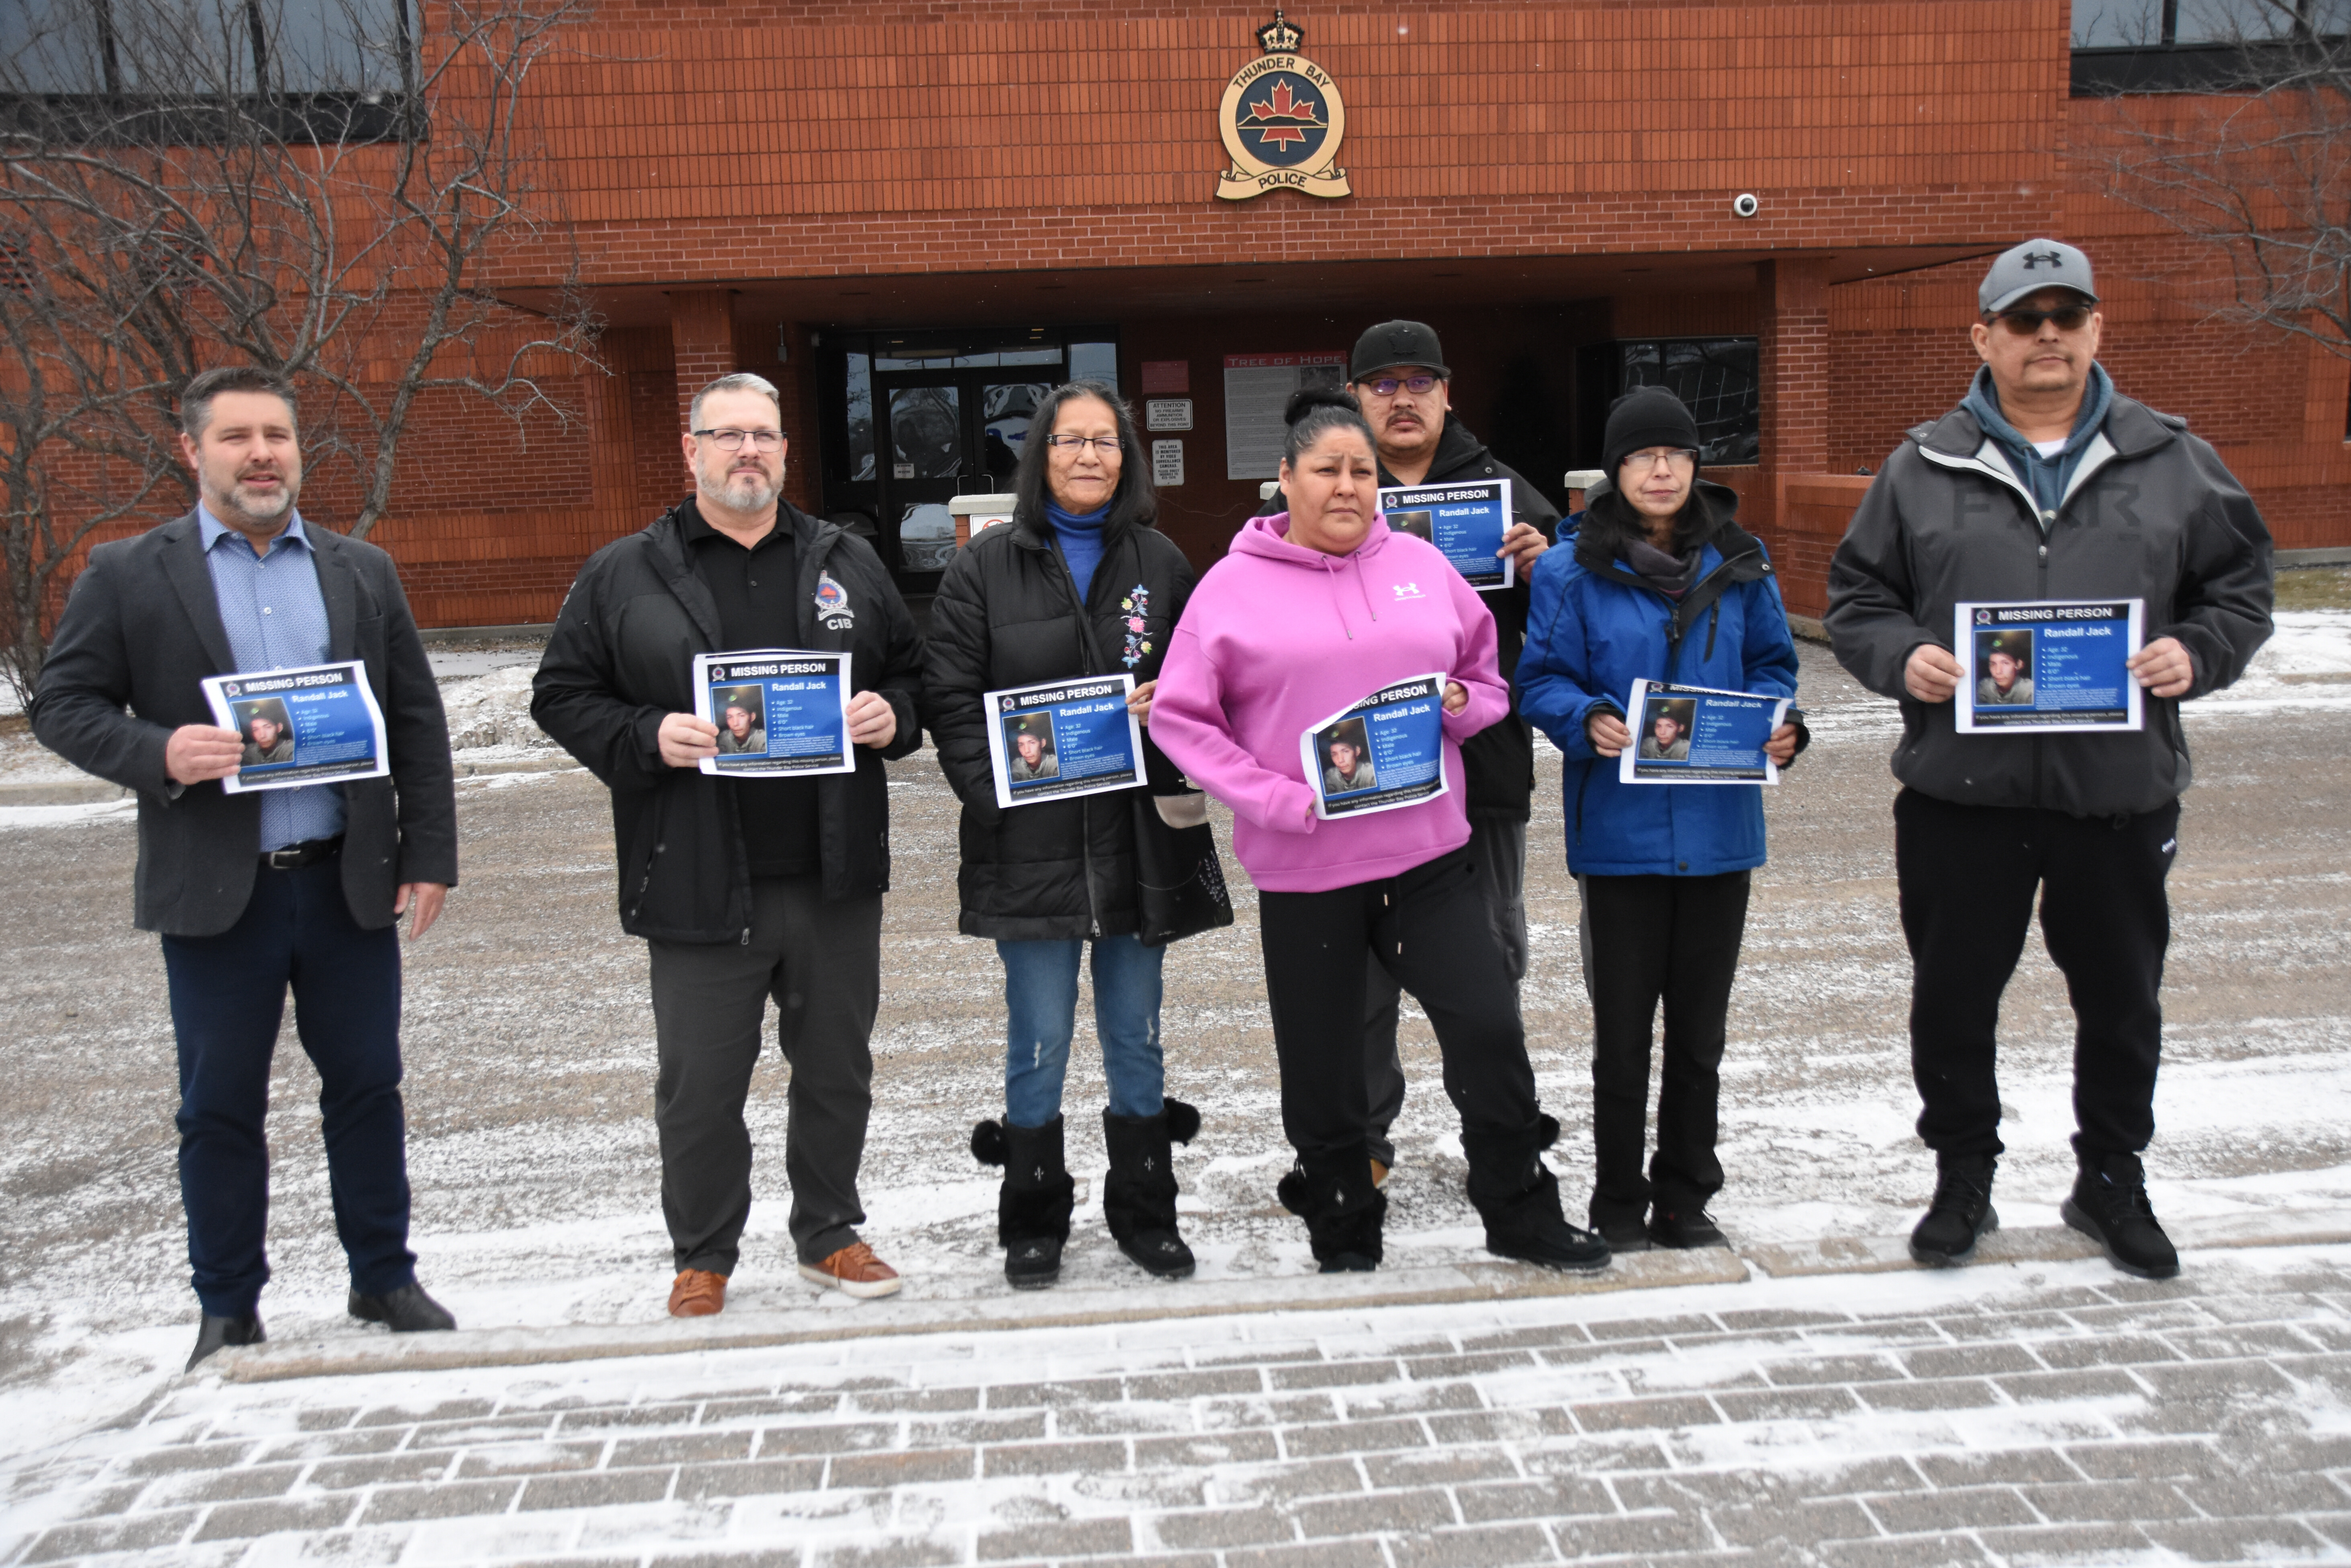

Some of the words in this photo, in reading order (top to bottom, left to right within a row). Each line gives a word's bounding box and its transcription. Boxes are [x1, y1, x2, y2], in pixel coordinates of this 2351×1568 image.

[1233, 57, 1295, 89] THUNDER
[1305, 64, 1330, 88] BAY
[1258, 173, 1307, 189] POLICE
[1403, 493, 1444, 504] MISSING
[1447, 490, 1488, 500] PERSON
[1439, 508, 1469, 517] Randall
[1998, 609, 2053, 621] MISSING
[2057, 608, 2112, 619] PERSON
[827, 618, 853, 630] CIB
[2044, 627, 2083, 638] Randall
[2086, 626, 2111, 636] Jack
[731, 665, 778, 677] MISSING
[780, 663, 826, 674] PERSON
[246, 679, 294, 692] MISSING
[296, 673, 343, 687] PERSON
[772, 683, 805, 691] Randall
[806, 681, 826, 690] Jack
[292, 692, 326, 703] Randall
[328, 690, 348, 699] Jack
[1020, 691, 1064, 706] MISSING
[1067, 685, 1112, 699] PERSON
[1381, 685, 1428, 702] PERSON
[1060, 706, 1092, 717] Randall
[1094, 703, 1114, 712] Jack
[1706, 699, 1739, 707] Randall
[1373, 708, 1408, 722] Randall
[1410, 704, 1431, 715] Jack
[1381, 734, 1407, 742] Indigenous
